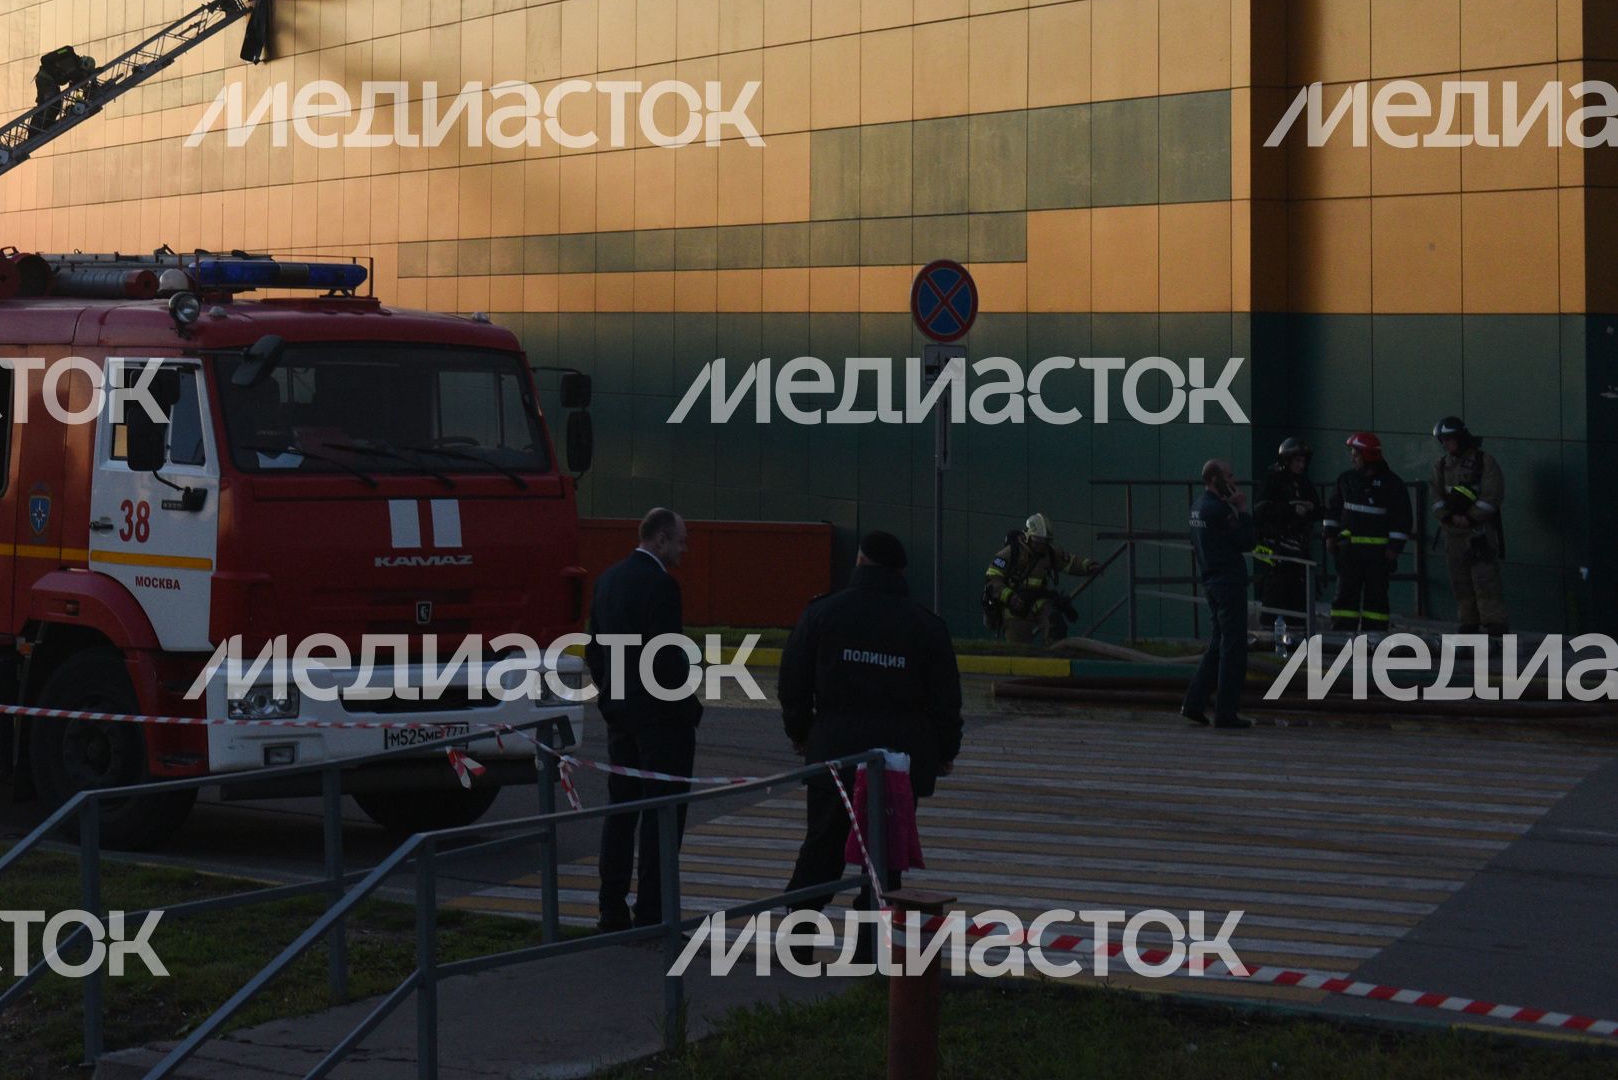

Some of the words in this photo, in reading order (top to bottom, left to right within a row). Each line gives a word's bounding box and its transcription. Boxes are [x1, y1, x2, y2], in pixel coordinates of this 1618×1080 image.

[119, 499, 151, 543] 38
[374, 554, 474, 568] KAMAZ
[134, 575, 181, 591] МОСКВА
[842, 648, 907, 669] ПОЛИЦИЯ
